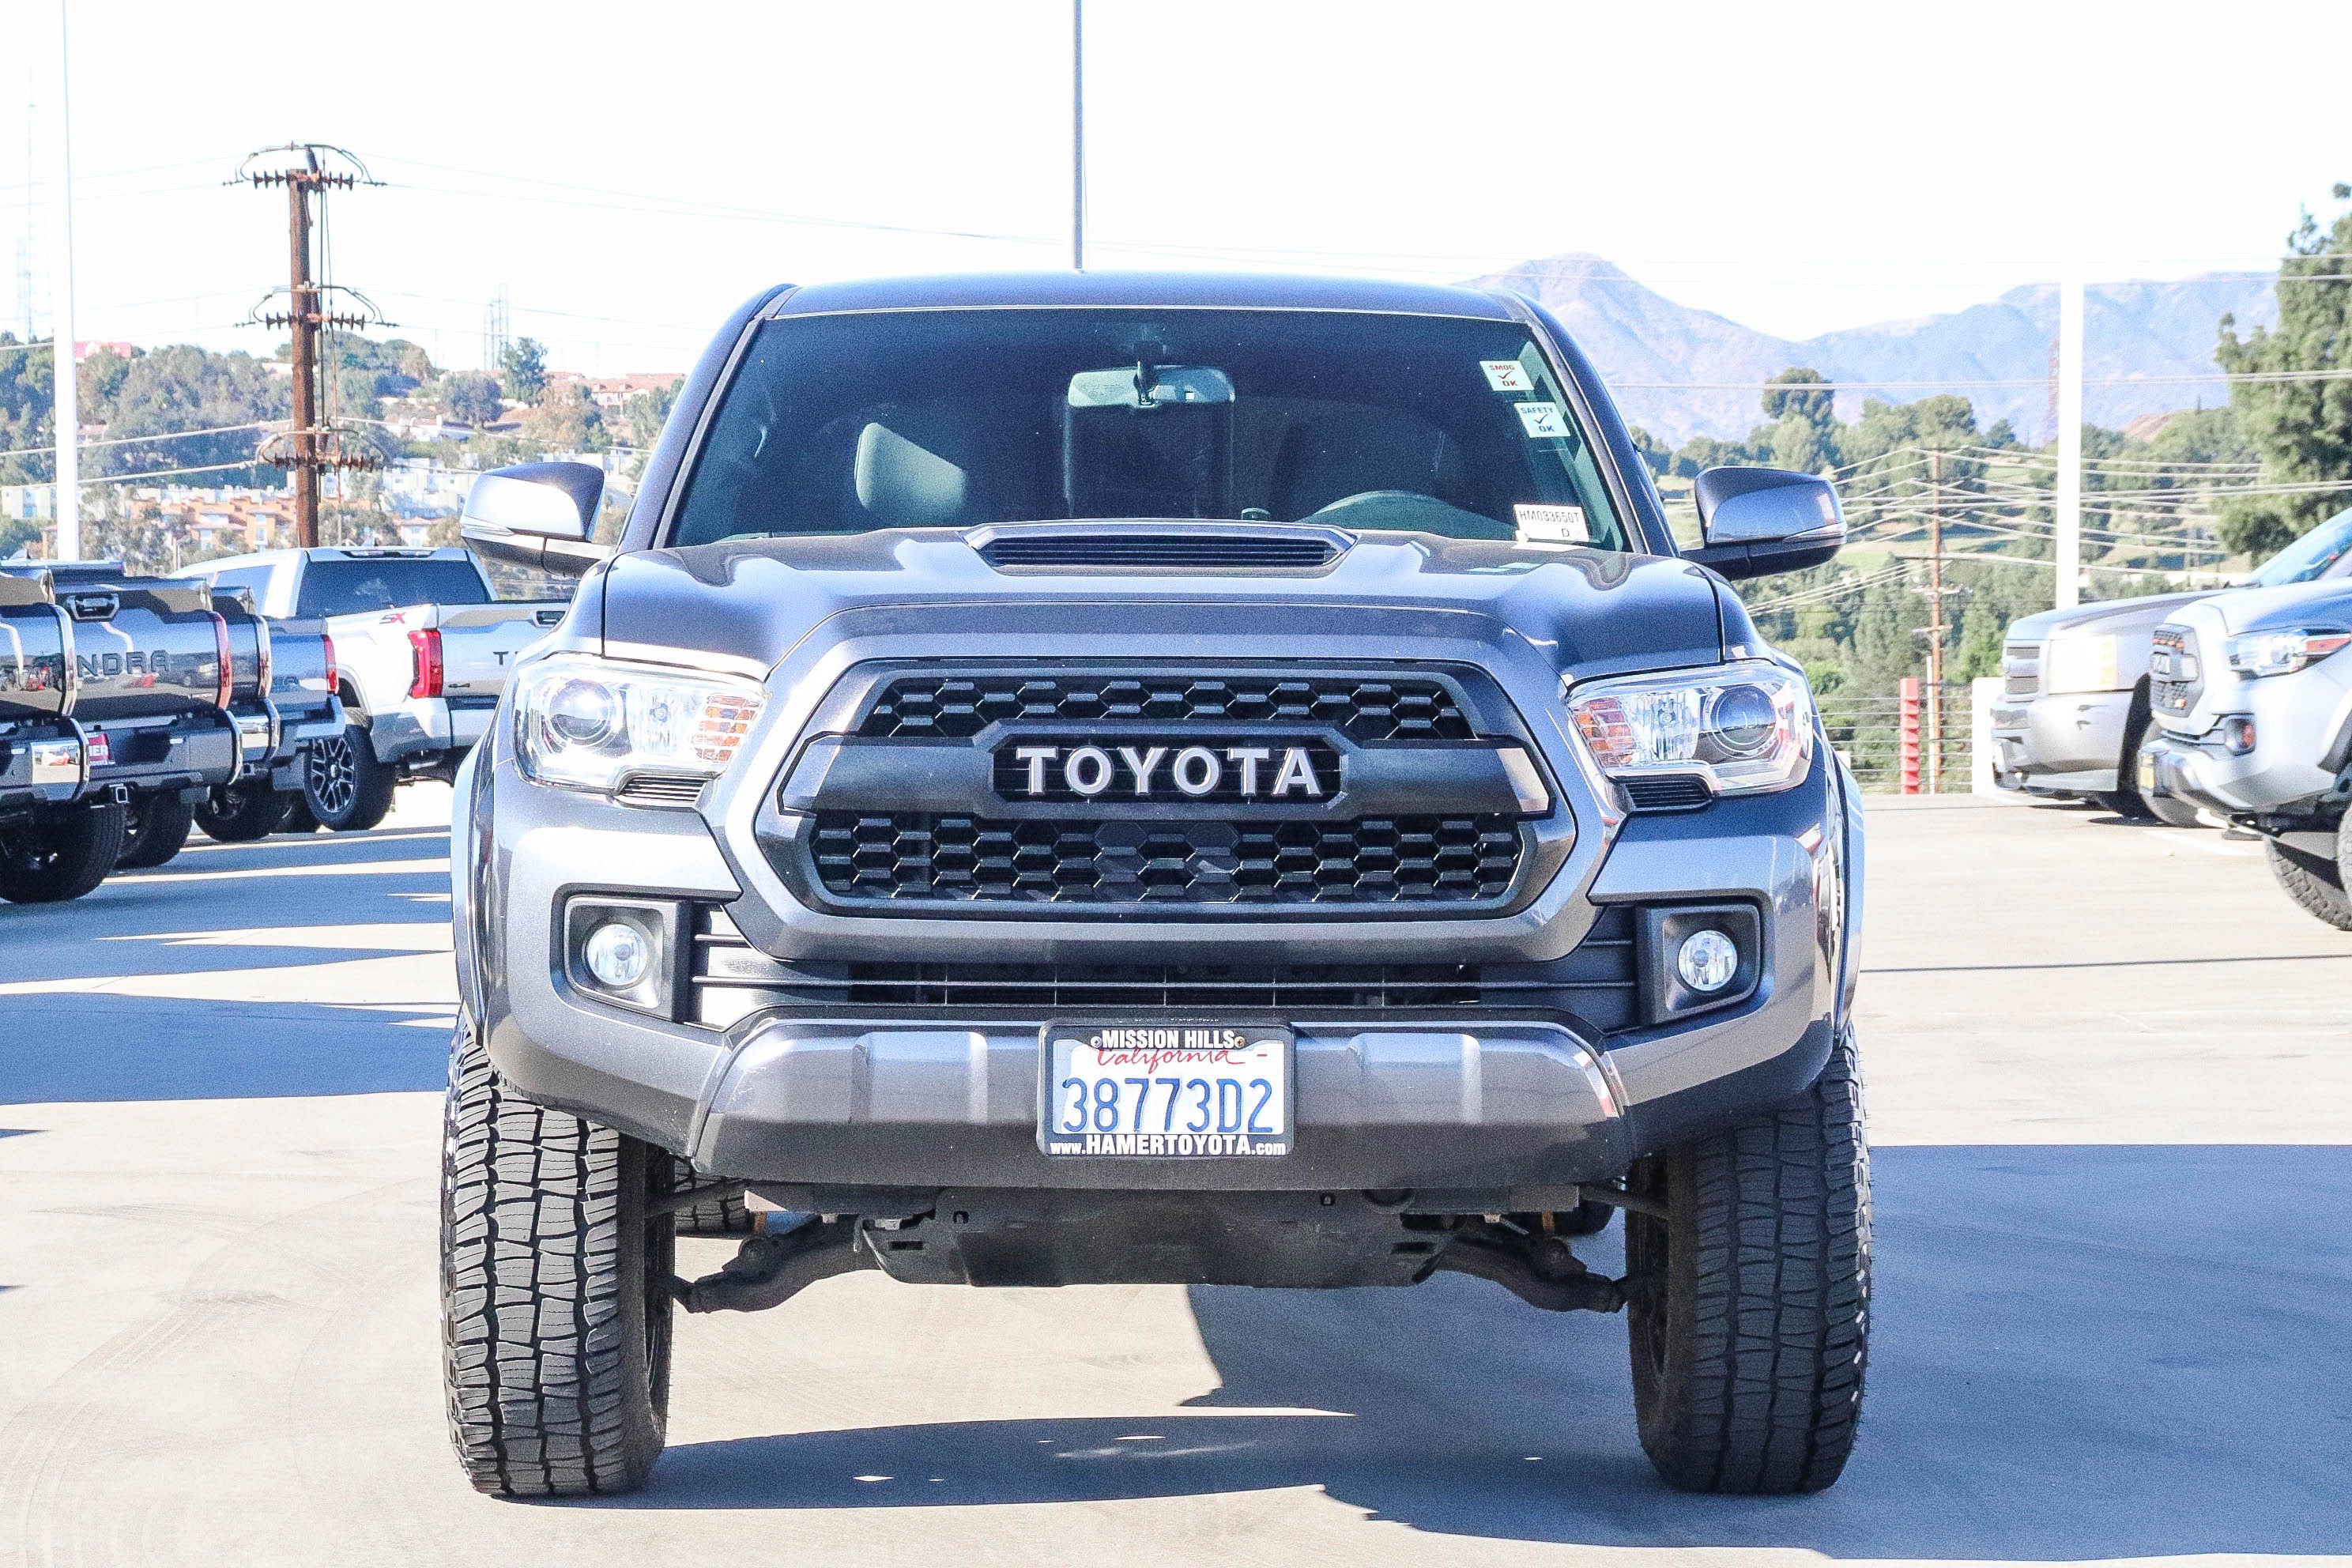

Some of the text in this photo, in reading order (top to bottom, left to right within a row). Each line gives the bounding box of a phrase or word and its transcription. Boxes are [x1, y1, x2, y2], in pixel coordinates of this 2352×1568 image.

[77, 650, 171, 677] NDRA
[1016, 745, 1323, 796] TOYOTA
[1101, 1030, 1236, 1049] MISSION HILLS
[1096, 1049, 1246, 1075] California
[1062, 1078, 1273, 1133] 38773D2
[1050, 1134, 1287, 1155] www.HAMERTOYOTA.com
